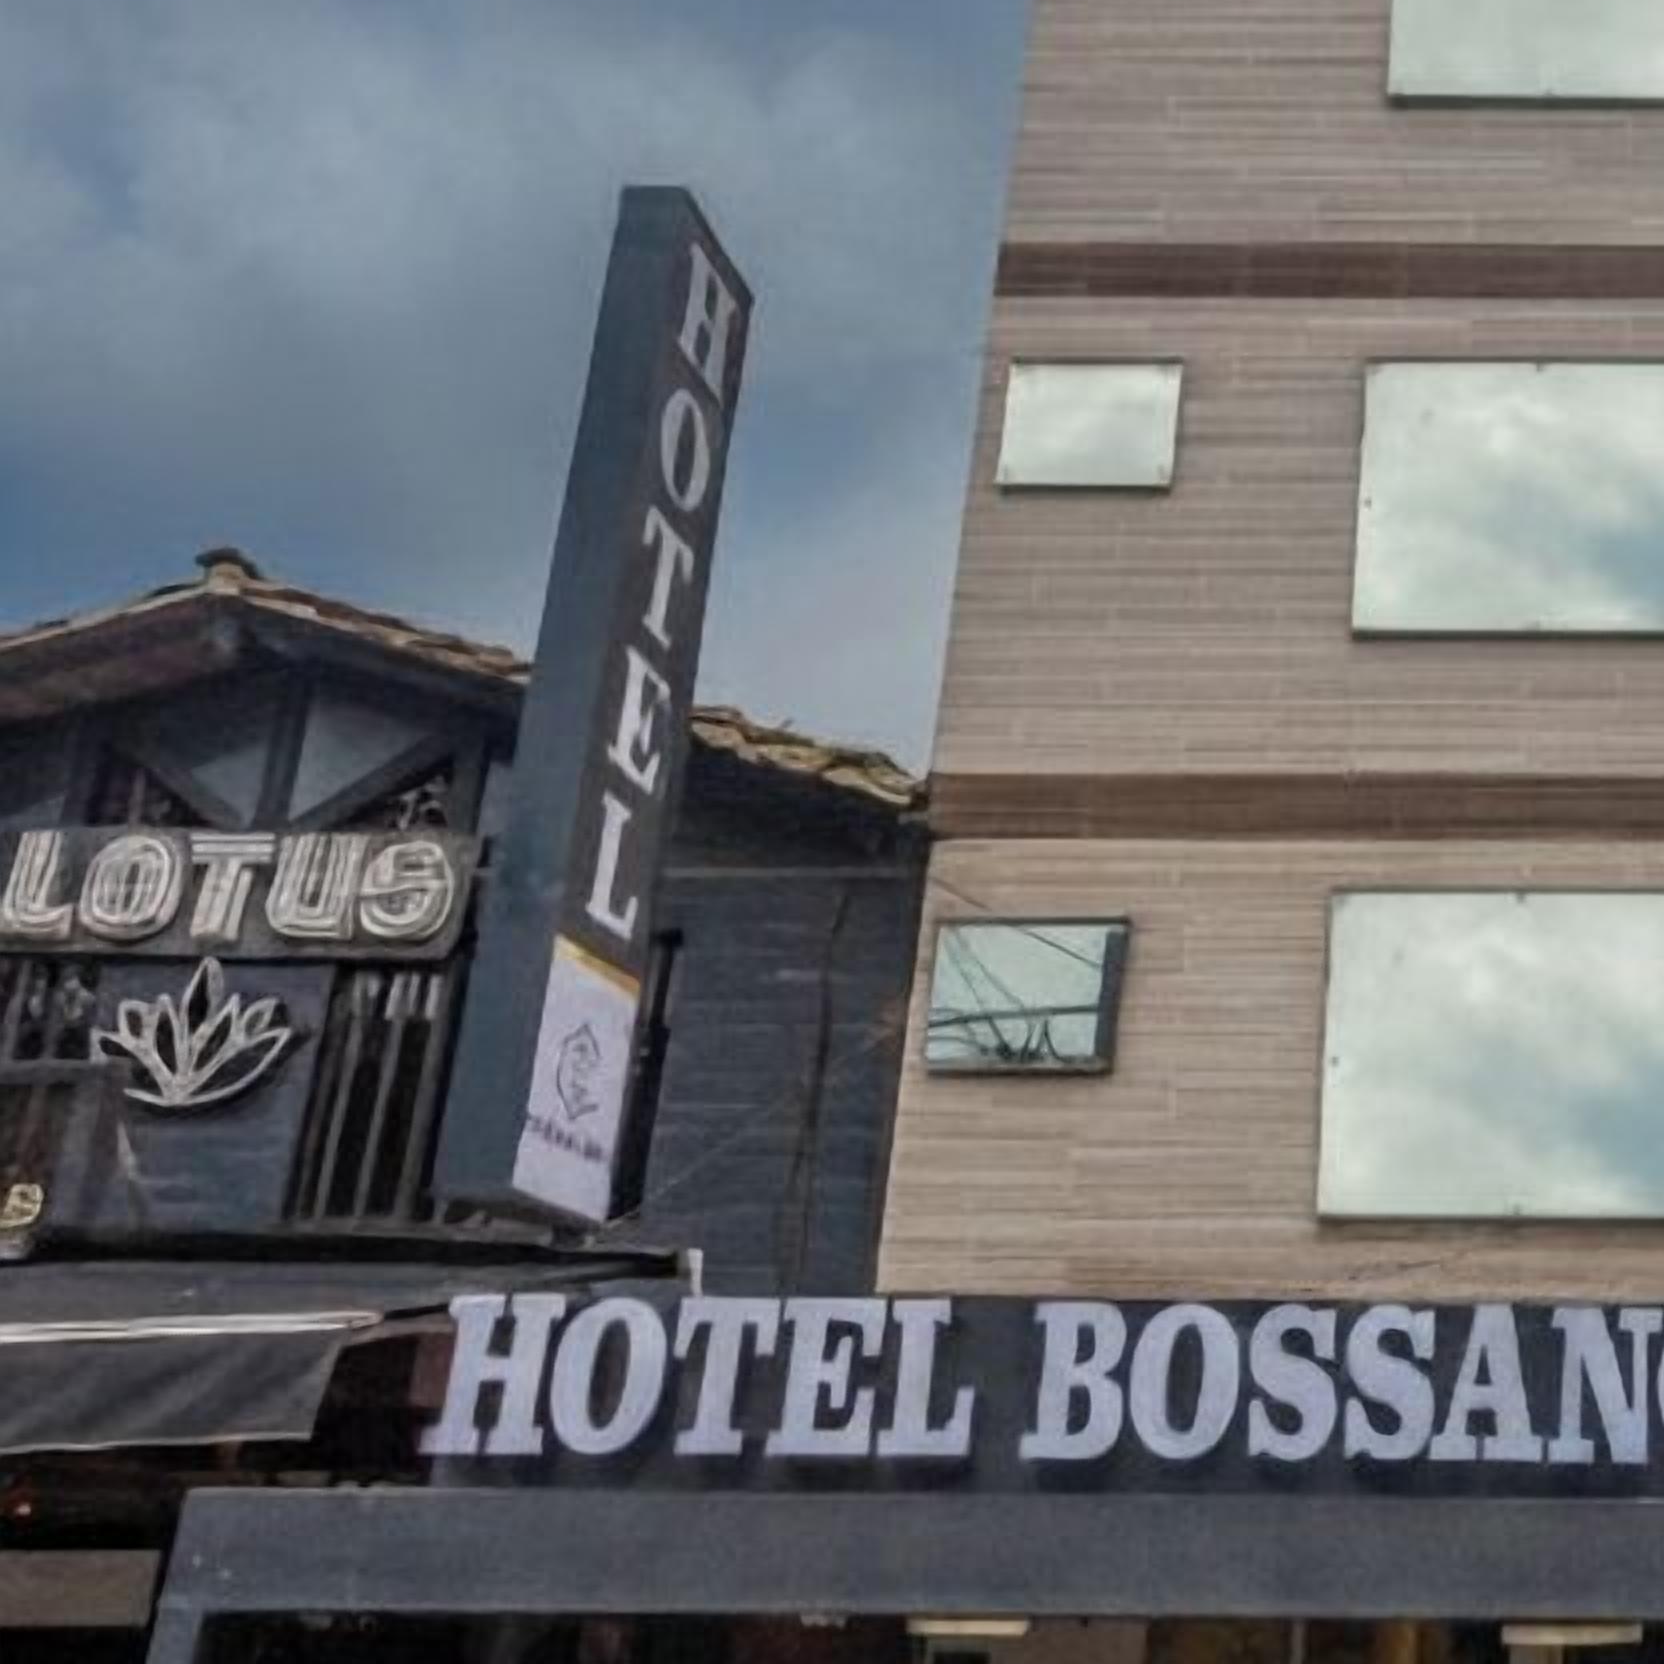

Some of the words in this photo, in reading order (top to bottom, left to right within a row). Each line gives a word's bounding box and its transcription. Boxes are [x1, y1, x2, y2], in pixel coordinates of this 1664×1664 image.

[586, 242, 740, 940] HOTEL
[3, 830, 455, 939] LOTUS
[418, 1293, 976, 1457] HOTEL
